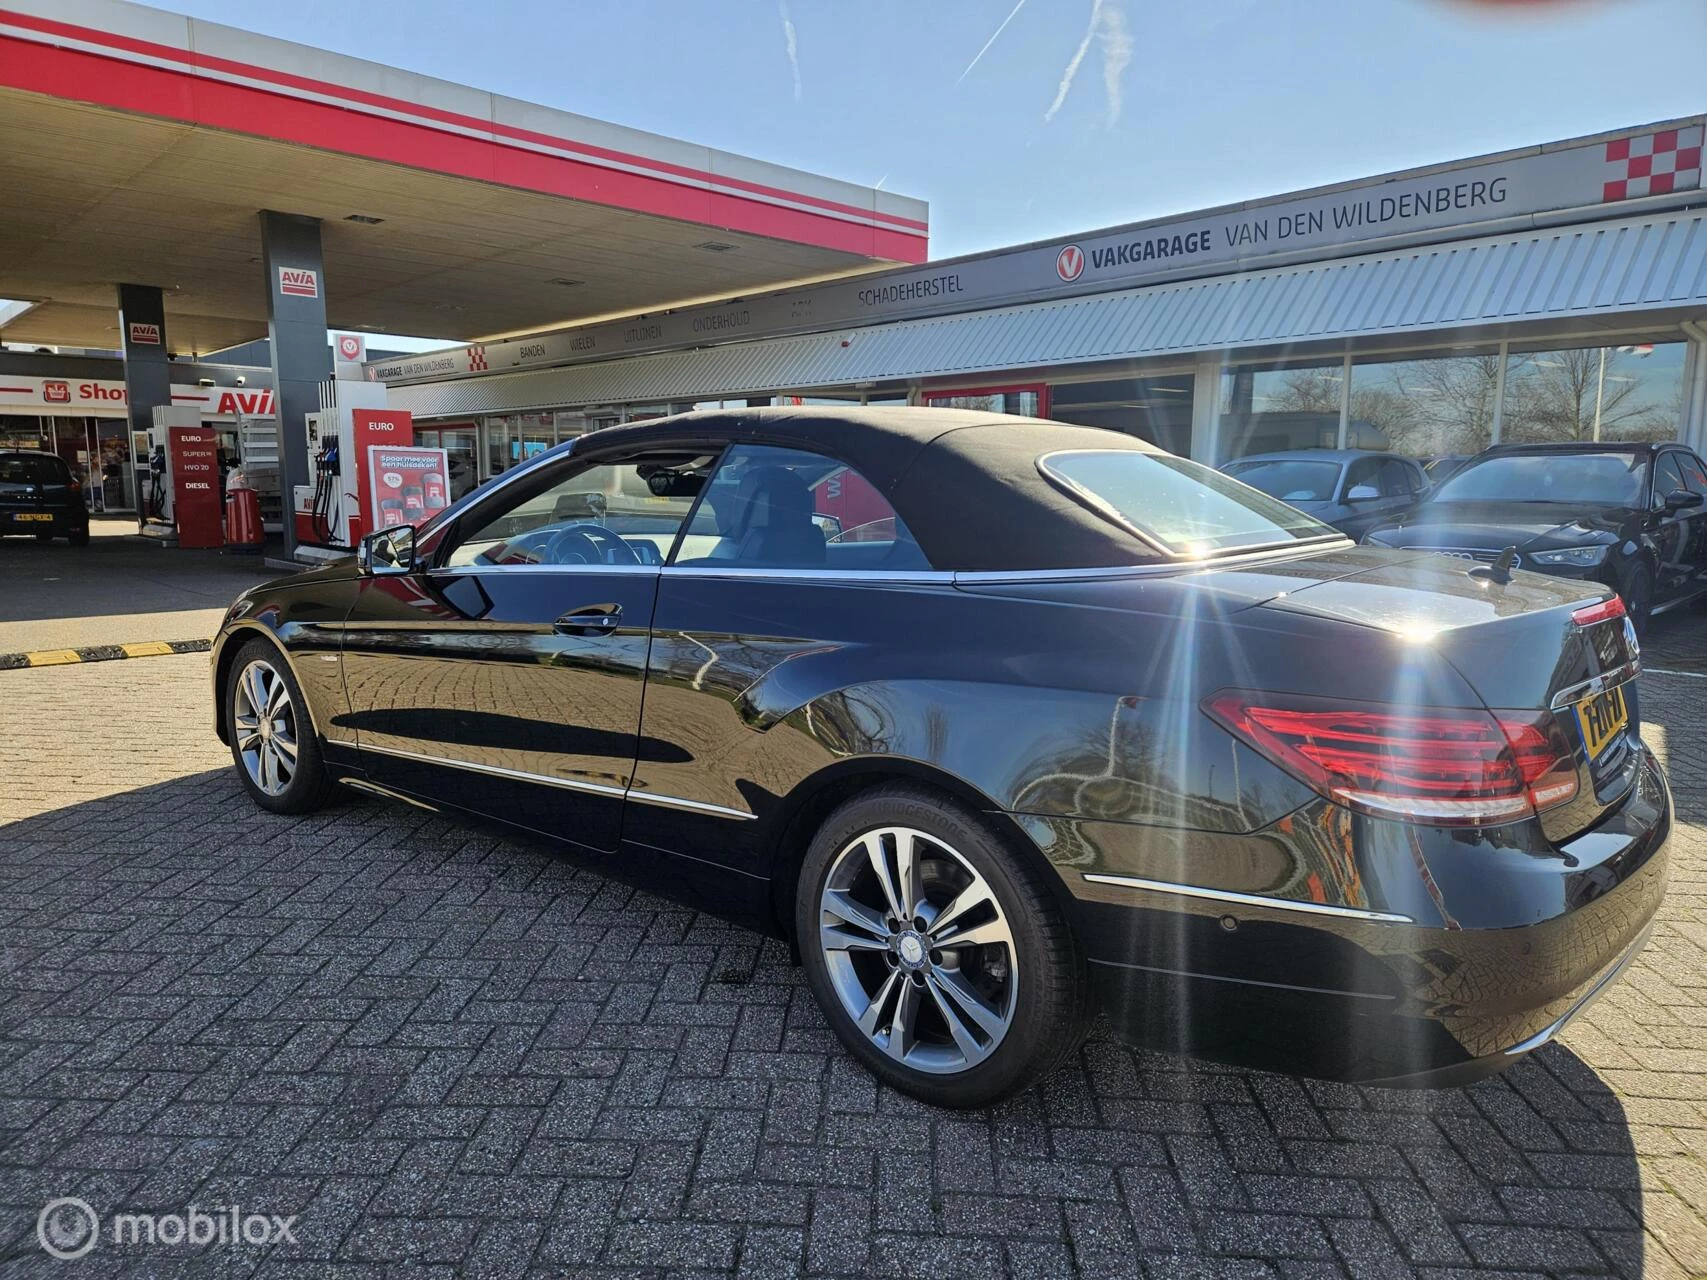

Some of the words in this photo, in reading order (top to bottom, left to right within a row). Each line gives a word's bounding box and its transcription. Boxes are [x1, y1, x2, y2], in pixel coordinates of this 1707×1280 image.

[1092, 230, 1211, 270] VAKGARAGE
[1225, 219, 1268, 247] VAN
[1277, 210, 1323, 238] DEN
[1332, 176, 1507, 231] WILDENBERG
[857, 274, 964, 307] SCHADEHERSTEL
[692, 311, 750, 333] ONDERHOUD
[519, 343, 546, 359] BANDEN
[569, 335, 597, 352] WIELEN
[368, 422, 395, 431] EURO
